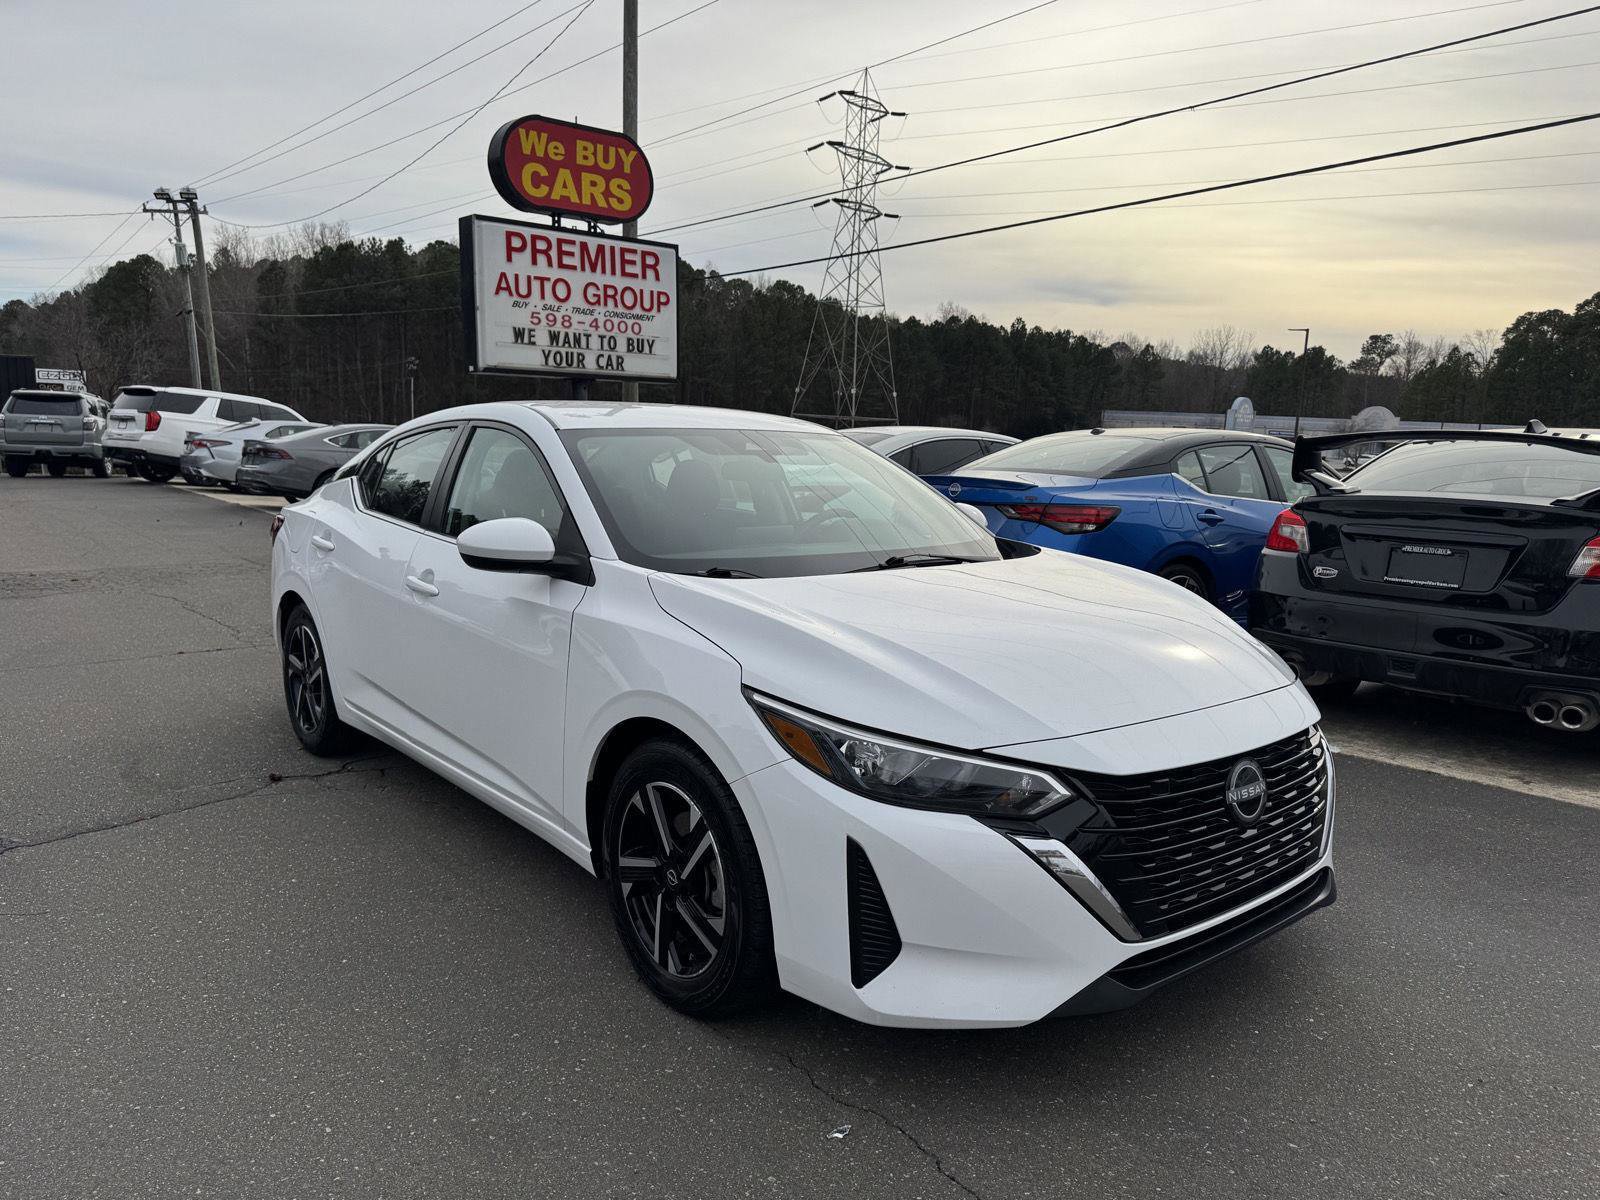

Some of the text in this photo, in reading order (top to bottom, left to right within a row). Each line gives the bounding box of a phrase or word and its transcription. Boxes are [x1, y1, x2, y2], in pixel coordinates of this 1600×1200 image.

[518, 128, 637, 174] We BUY
[522, 162, 633, 211] CARS
[505, 230, 661, 282] PREMIER
[494, 271, 671, 313] AUTO GROUP
[512, 300, 656, 322] BUY SALE TRADE CONSIGNMENT
[530, 311, 643, 335] 598-4000
[512, 327, 656, 355] WE WANT TO BUY
[542, 350, 625, 372] YOUR CAR
[1228, 783, 1266, 801] NISSAN
